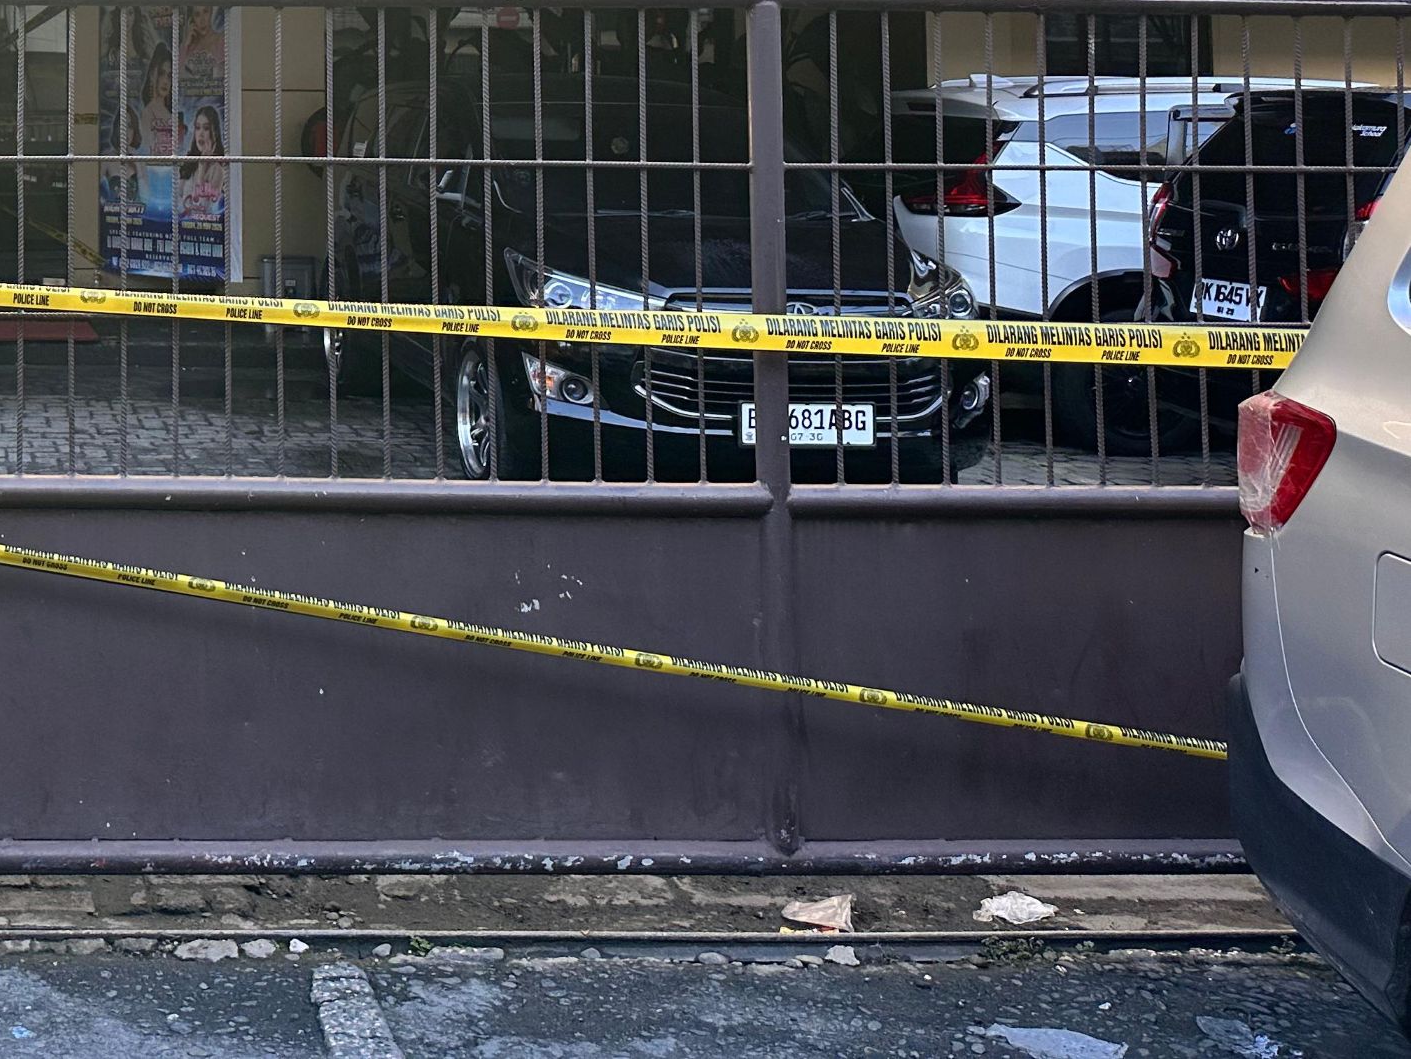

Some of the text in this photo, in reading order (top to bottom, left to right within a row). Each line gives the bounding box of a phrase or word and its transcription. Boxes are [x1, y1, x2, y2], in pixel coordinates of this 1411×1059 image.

[12, 292, 49, 306] POLICE LINE
[1214, 284, 1243, 305] 1645
[133, 301, 177, 314] DO NOT CROSS
[225, 307, 262, 320] POLICE LINE
[347, 316, 392, 327] DO NOT CROSS
[441, 321, 479, 332] POLICE LINE
[545, 309, 721, 332] DILARANG MELINTAS GARIS POLISI
[565, 329, 611, 340] DO NOT CROSS
[765, 317, 941, 341] DILARANG MELINTAS GARIS POLISI
[661, 334, 699, 344] POLICE LINE
[985, 324, 1162, 348] DILARANG MELINTAS GARIS POLISI
[1207, 330, 1305, 352] DILARANG MELINT
[785, 339, 831, 350] DO NOT CROSS
[881, 343, 919, 353] POLICE LINE
[1005, 347, 1051, 358] DO NOT CROSS
[1101, 350, 1139, 361] POLICE LINE
[1226, 353, 1273, 365] DO NOT CROSS
[117, 573, 139, 583] POLICE
[141, 577, 155, 585] LINE
[242, 595, 252, 603] DO
[253, 597, 265, 605] NOT
[266, 599, 289, 609] CROSS
[338, 611, 361, 621] POLICE
[362, 615, 377, 624] LINE
